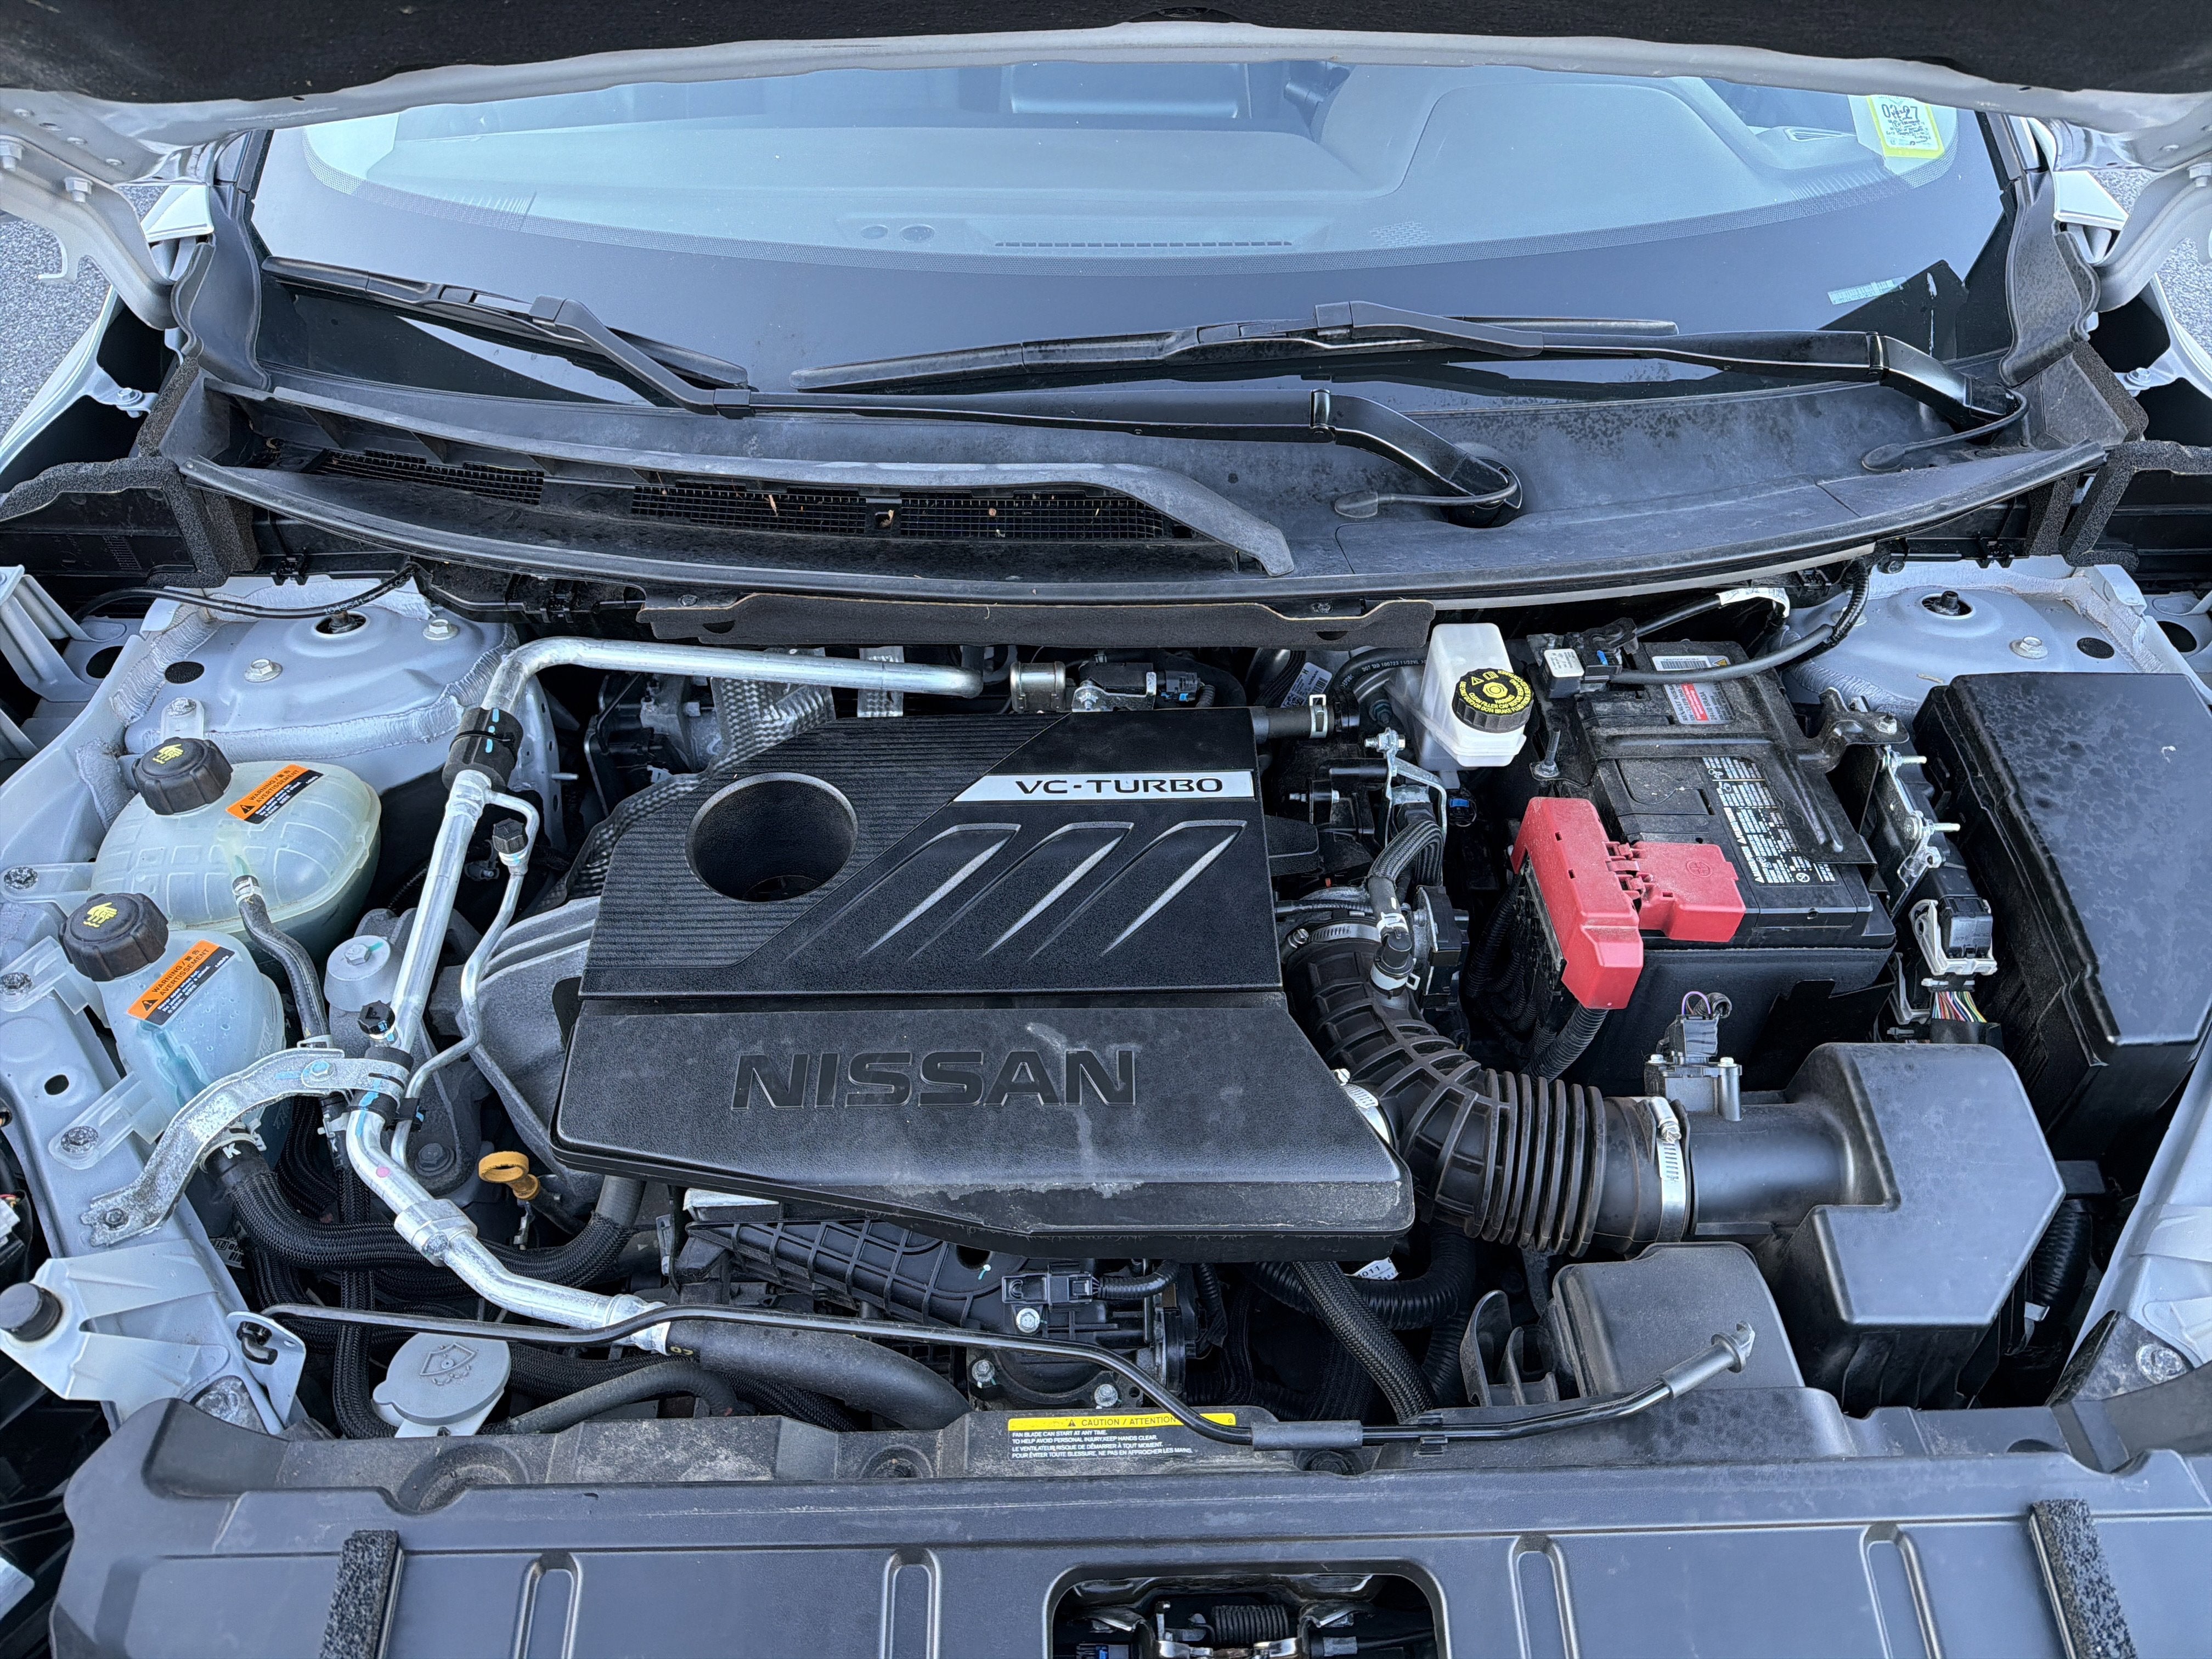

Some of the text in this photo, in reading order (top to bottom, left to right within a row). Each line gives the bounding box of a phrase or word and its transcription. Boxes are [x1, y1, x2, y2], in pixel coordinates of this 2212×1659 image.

[1469, 692, 1482, 704] CLEAN
[1667, 685, 1679, 699] NISSA
[248, 780, 275, 801] WARNING
[256, 769, 301, 803] AVERTISSEMENT
[1014, 778, 1223, 795] VC-TURBO
[152, 966, 182, 992] WARNING
[160, 949, 209, 995] AVERTISSEMENT
[730, 1049, 1136, 1110] NISSAN
[222, 1143, 241, 1159] K
[1081, 1418, 1120, 1426] CAUTION
[1130, 1416, 1177, 1425] ATTENTION
